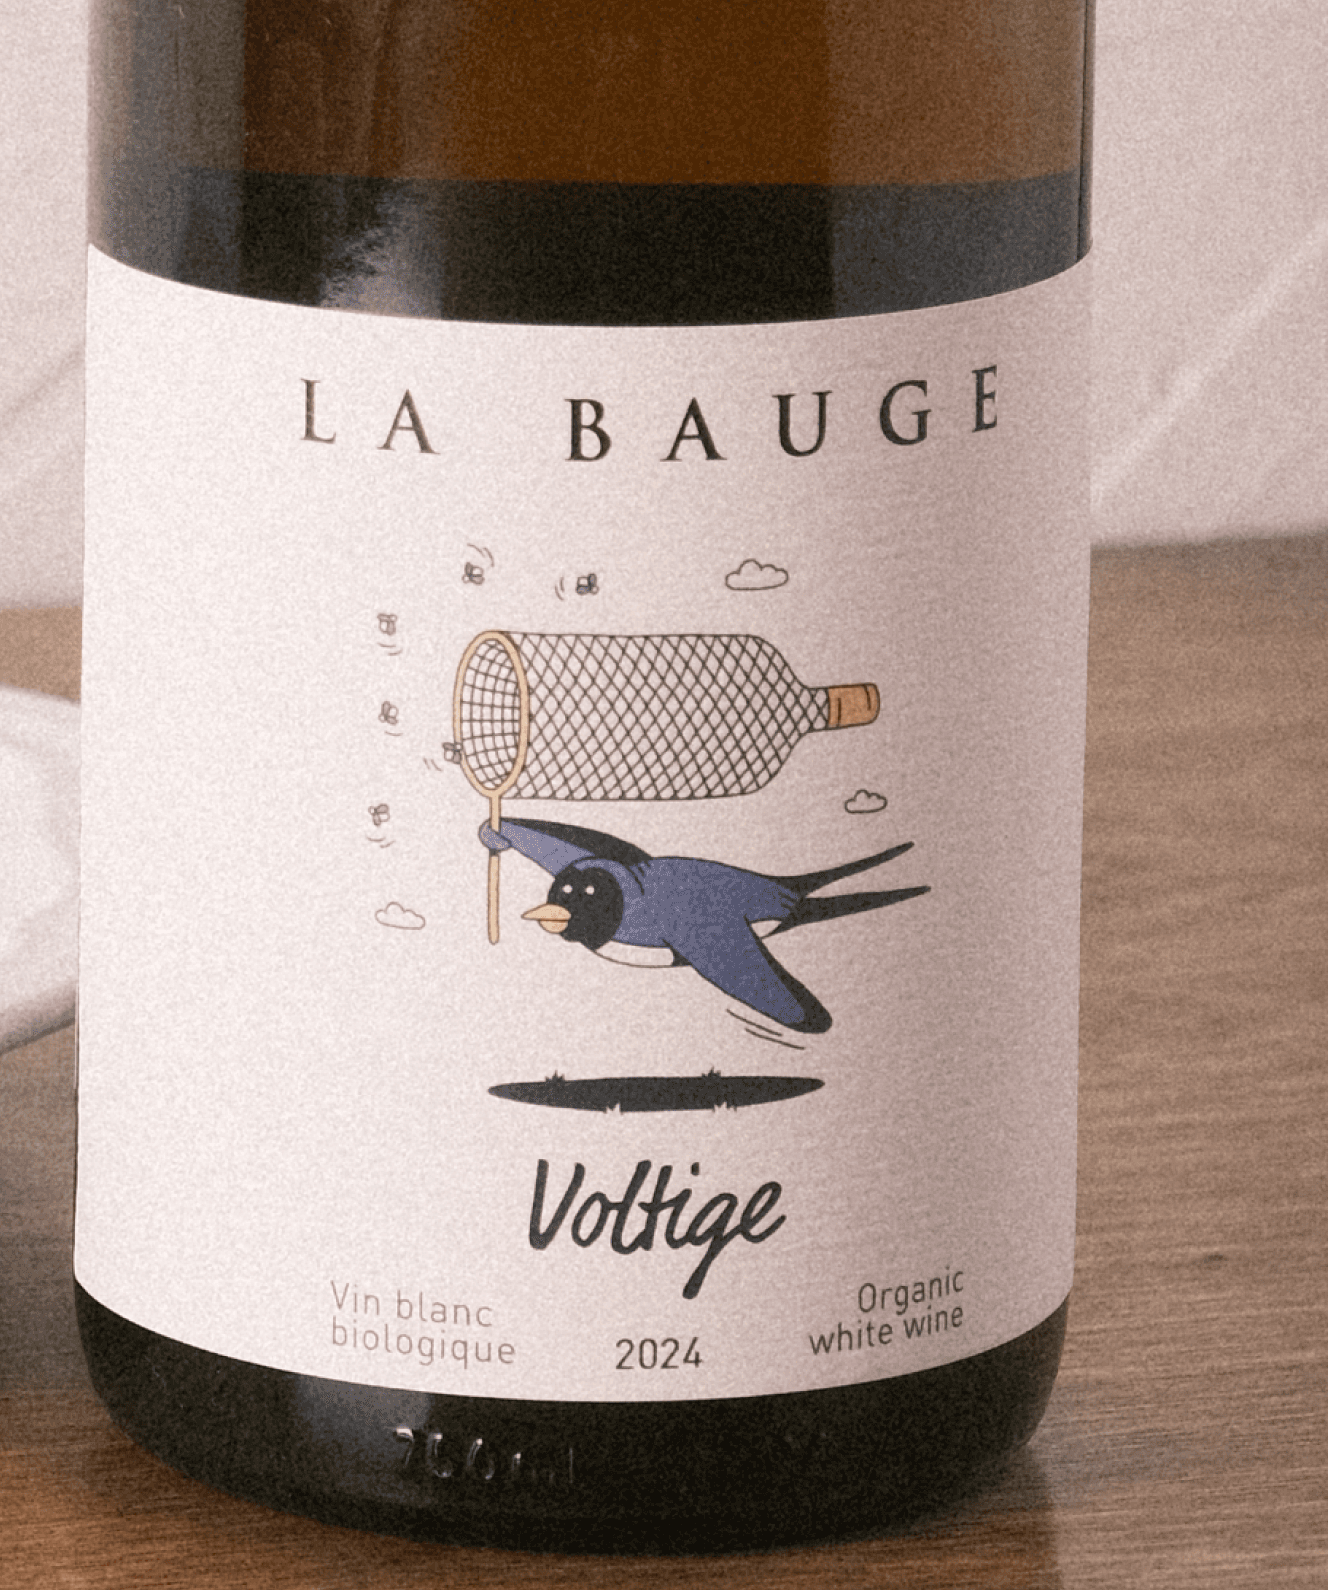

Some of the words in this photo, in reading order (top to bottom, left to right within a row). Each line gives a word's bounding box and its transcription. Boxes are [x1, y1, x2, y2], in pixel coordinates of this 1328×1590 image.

[299, 376, 439, 456] LA
[564, 364, 998, 463] BAUGE
[526, 1158, 787, 1301] Voltige
[329, 1279, 381, 1316] Vin
[396, 1288, 493, 1328] blanc
[857, 1265, 965, 1316] Organic
[331, 1314, 516, 1370] biologique
[615, 1336, 702, 1371] 2024
[808, 1318, 894, 1356] white
[902, 1304, 964, 1340] wine
